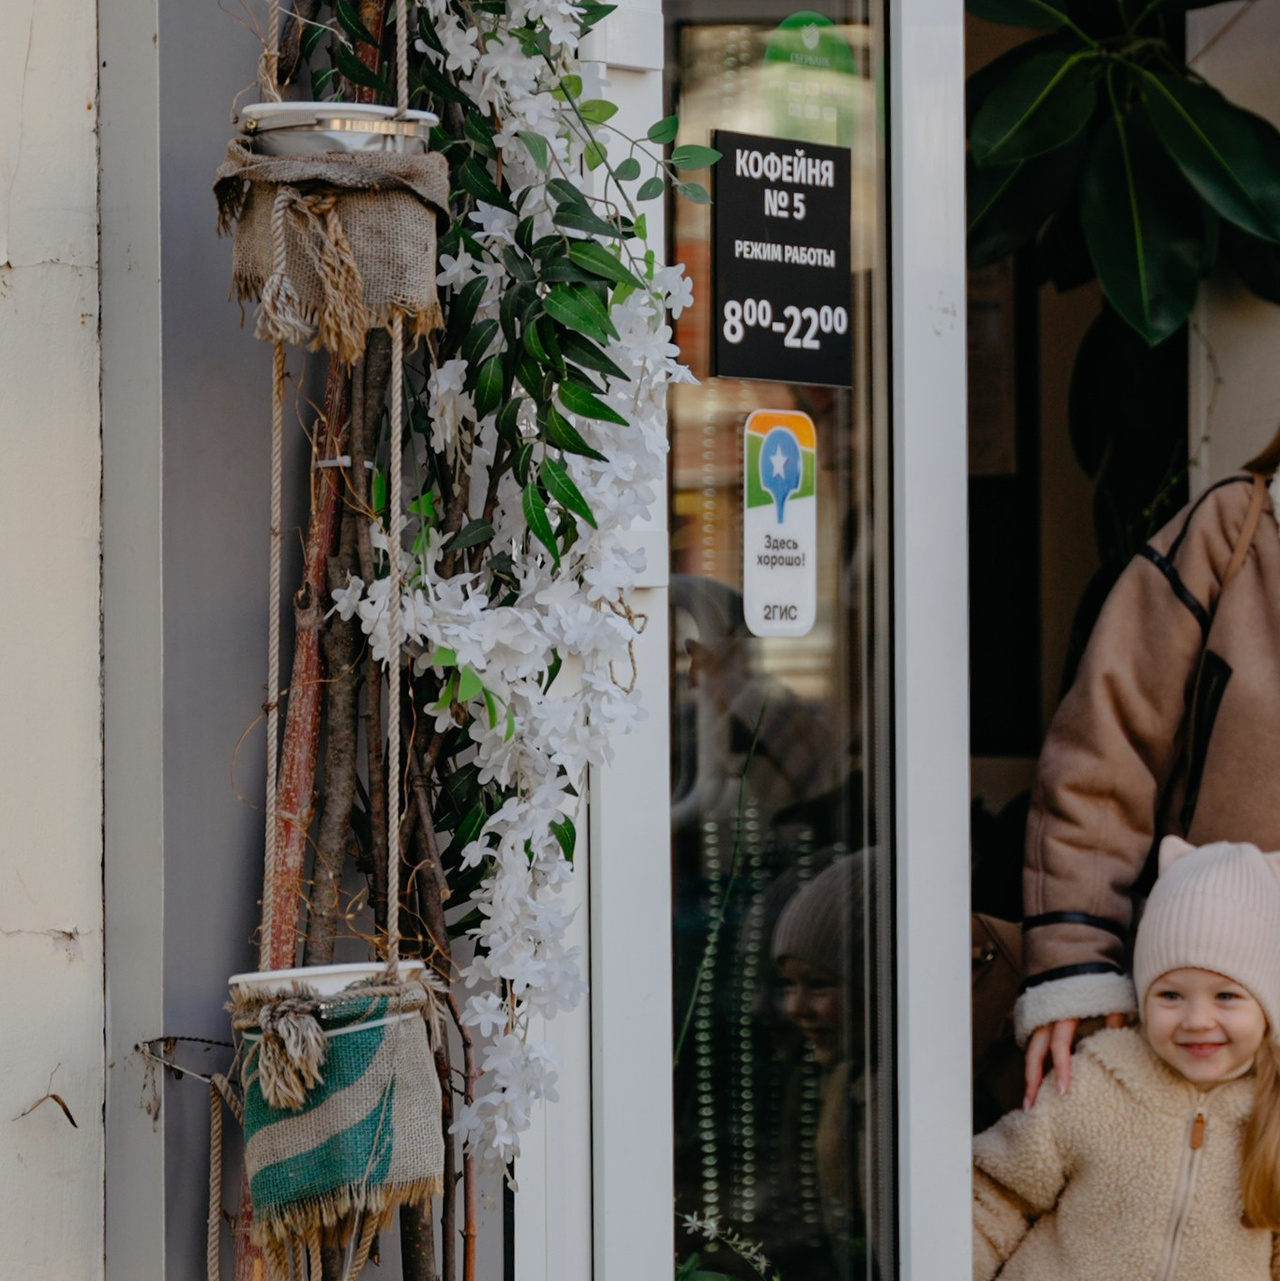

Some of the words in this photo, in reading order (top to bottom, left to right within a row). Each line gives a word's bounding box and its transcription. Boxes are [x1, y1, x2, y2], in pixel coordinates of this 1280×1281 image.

[735, 148, 834, 187] КОФЕЙНЯ
[764, 188, 789, 218] №
[793, 193, 806, 220] 5
[734, 239, 782, 263] РЕЖИМ
[784, 244, 836, 268] РАБОТЫ
[764, 534, 798, 551] Здесь
[757, 552, 806, 570] хорошо!
[763, 605, 798, 621] 2ГИС
